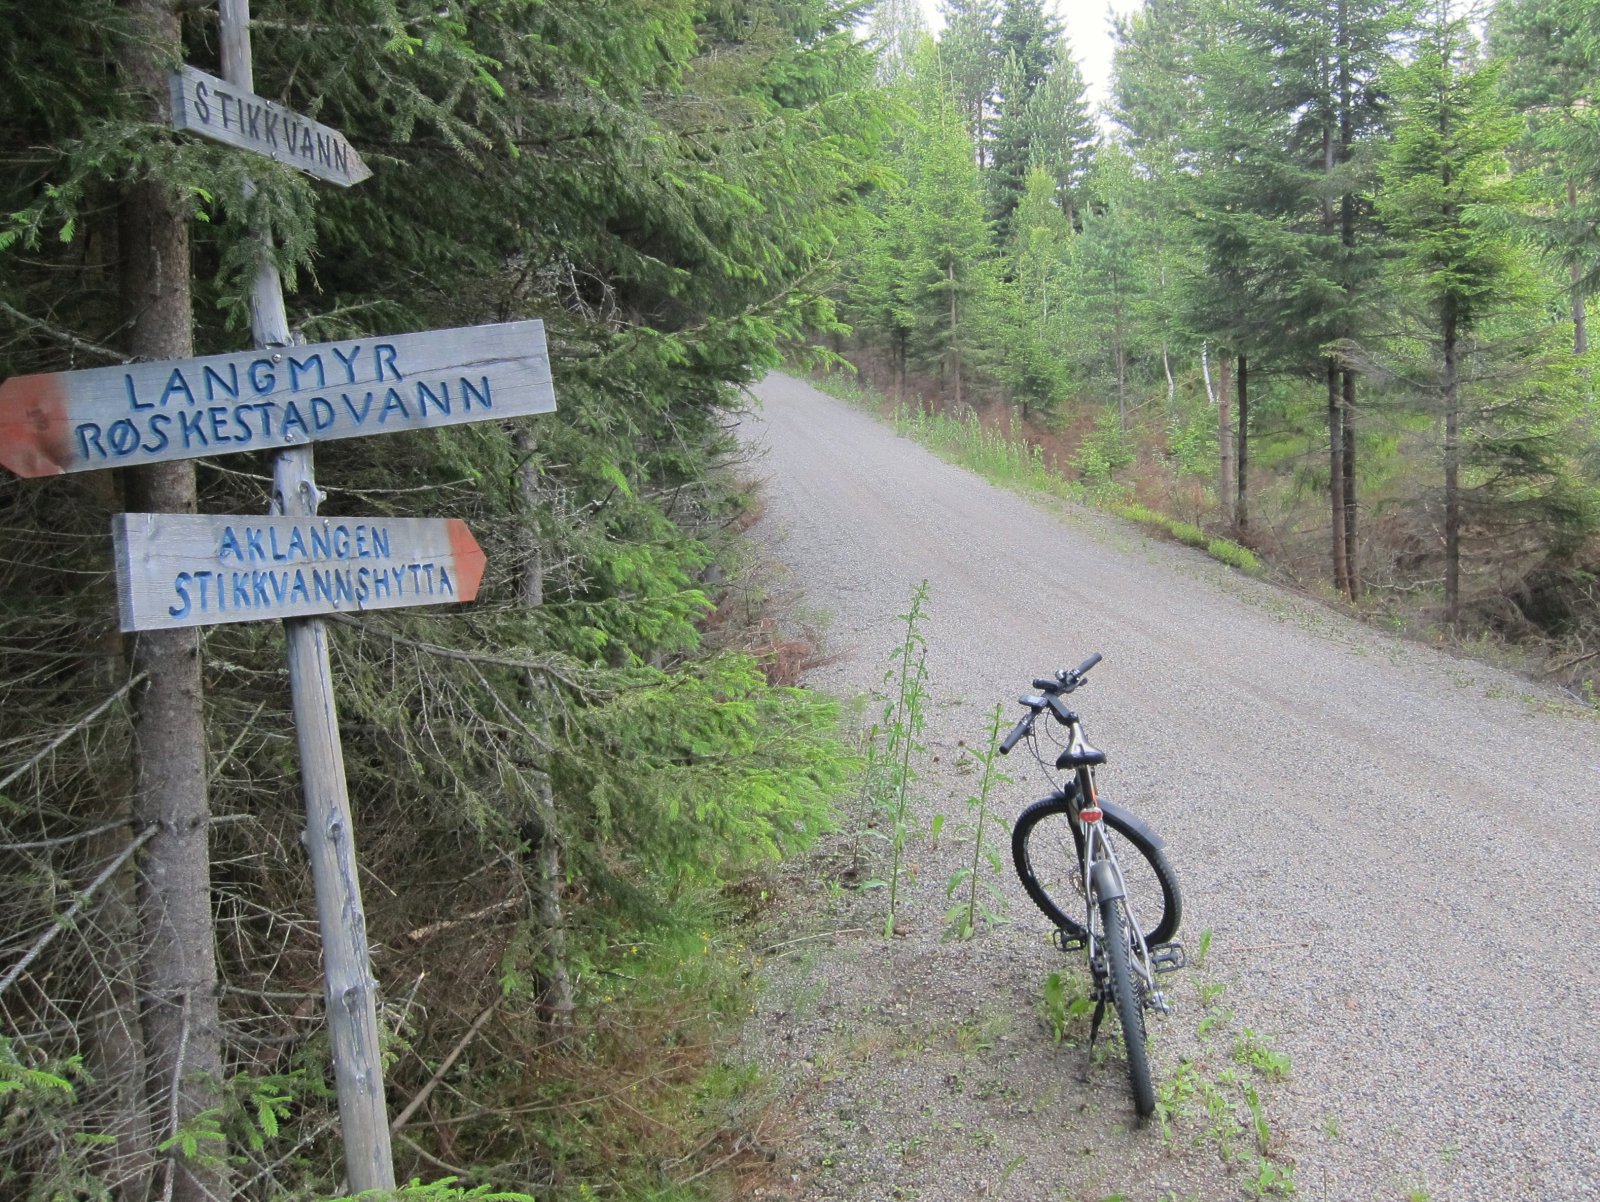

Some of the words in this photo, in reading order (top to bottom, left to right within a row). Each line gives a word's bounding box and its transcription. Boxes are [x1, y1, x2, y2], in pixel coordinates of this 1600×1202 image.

[194, 81, 349, 173] STIKKVANN
[126, 343, 403, 411] LANGMYR
[76, 375, 493, 460] RØSKESTADVANN
[219, 526, 390, 562] AKLANGEN
[168, 563, 454, 618] STIKKVANNSHYTTA
